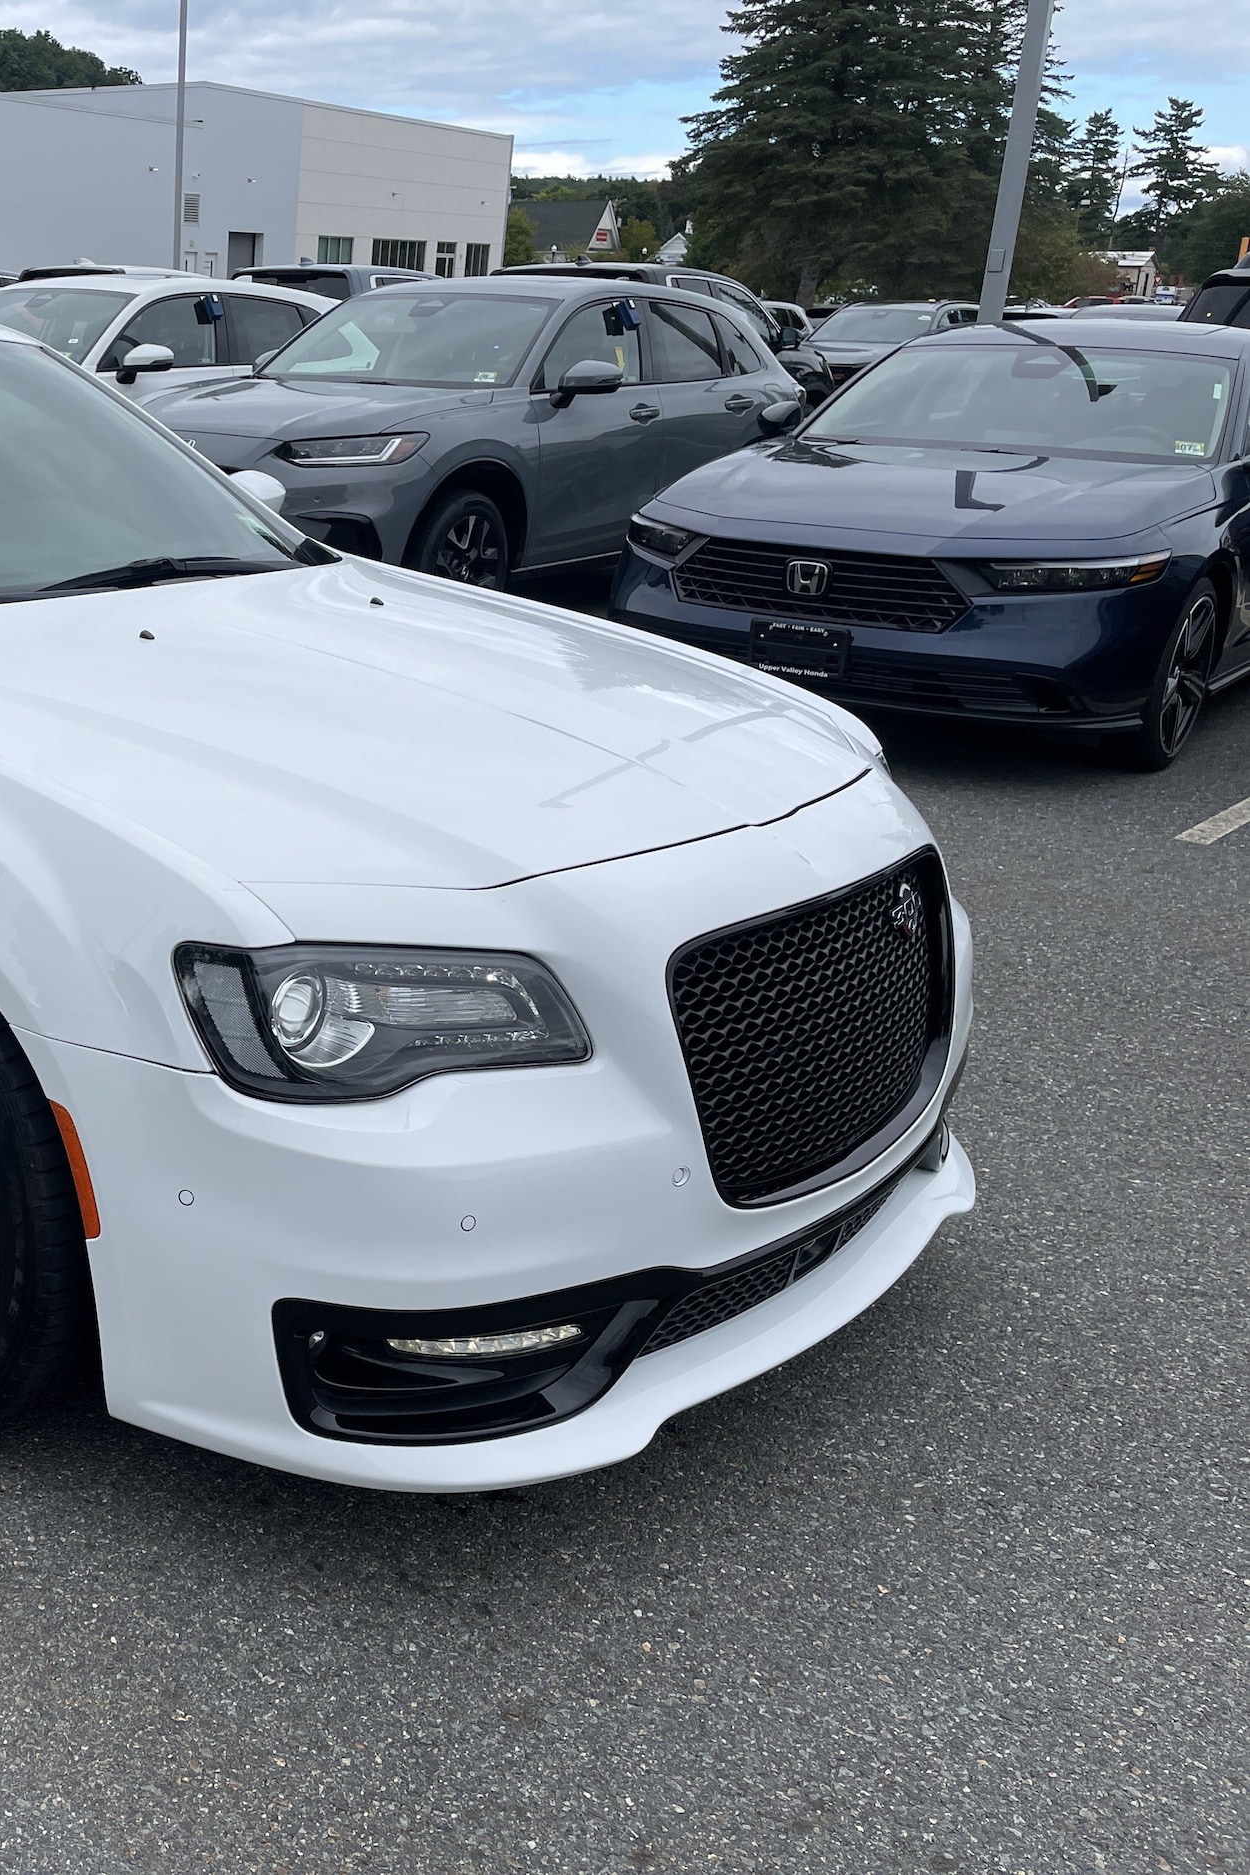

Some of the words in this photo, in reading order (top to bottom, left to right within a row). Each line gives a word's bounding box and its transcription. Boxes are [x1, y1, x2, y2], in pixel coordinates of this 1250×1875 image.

[758, 663, 780, 671] Upper
[781, 666, 804, 676] Valley
[804, 669, 828, 678] Honda
